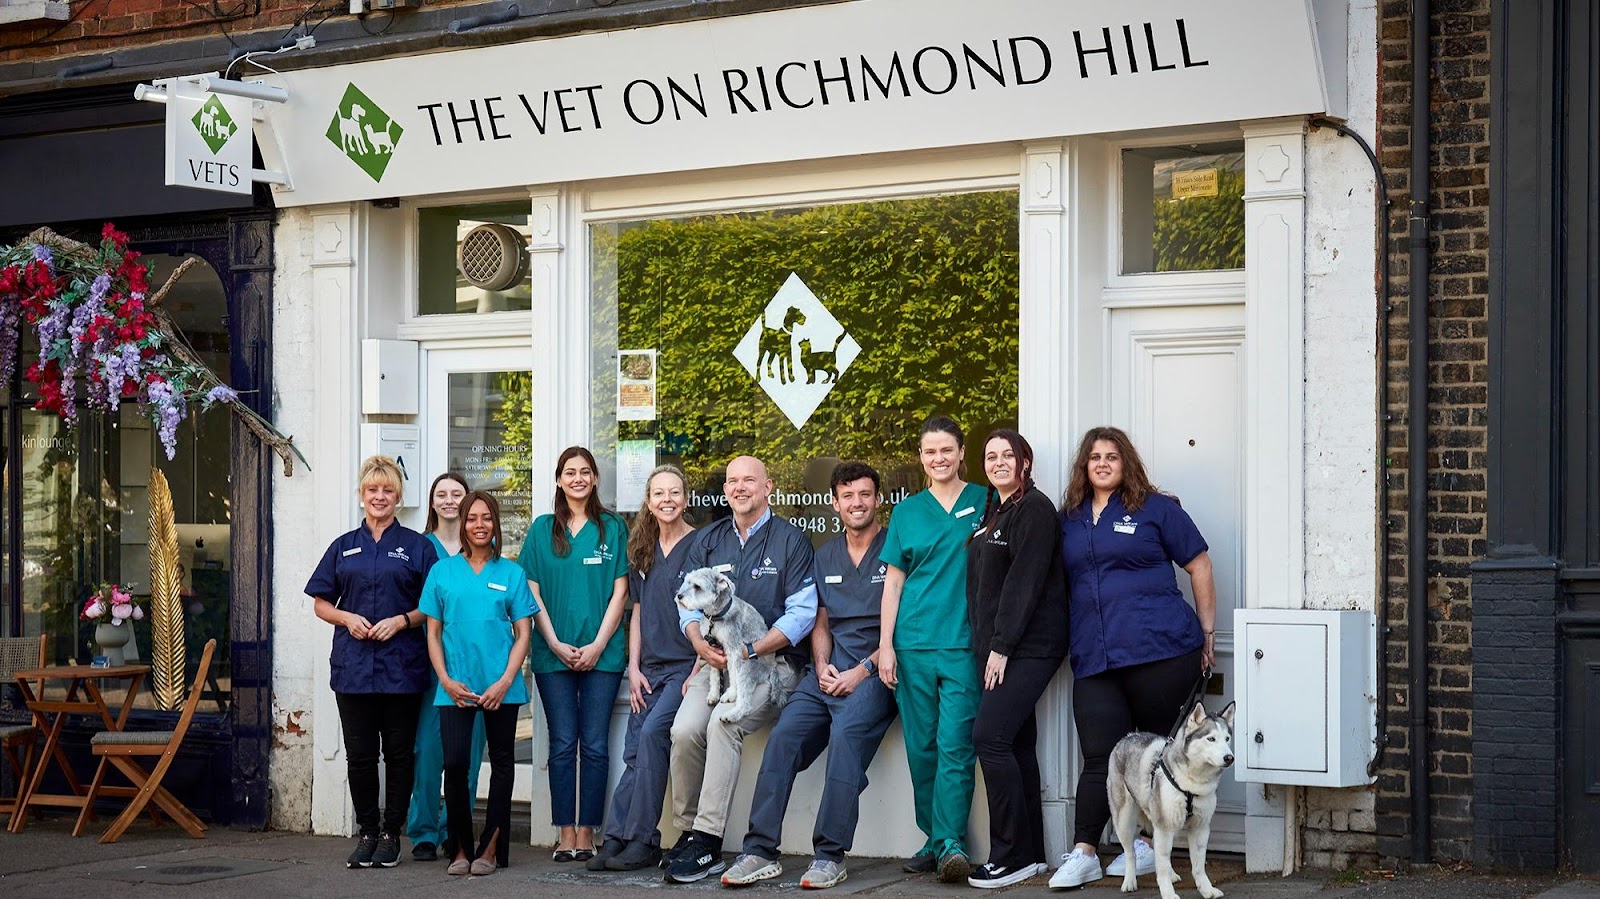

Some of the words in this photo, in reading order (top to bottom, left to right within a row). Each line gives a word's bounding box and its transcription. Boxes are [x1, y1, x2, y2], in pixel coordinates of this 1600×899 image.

[417, 96, 512, 146] THE
[518, 84, 603, 135] VET
[623, 73, 708, 125] ON
[722, 35, 1052, 115] RICHMOND
[1072, 18, 1210, 79] HILL
[188, 158, 239, 187] VETS
[21, 434, 71, 452] kinlounge
[471, 445, 502, 453] OPENING
[503, 444, 528, 453] HOURS
